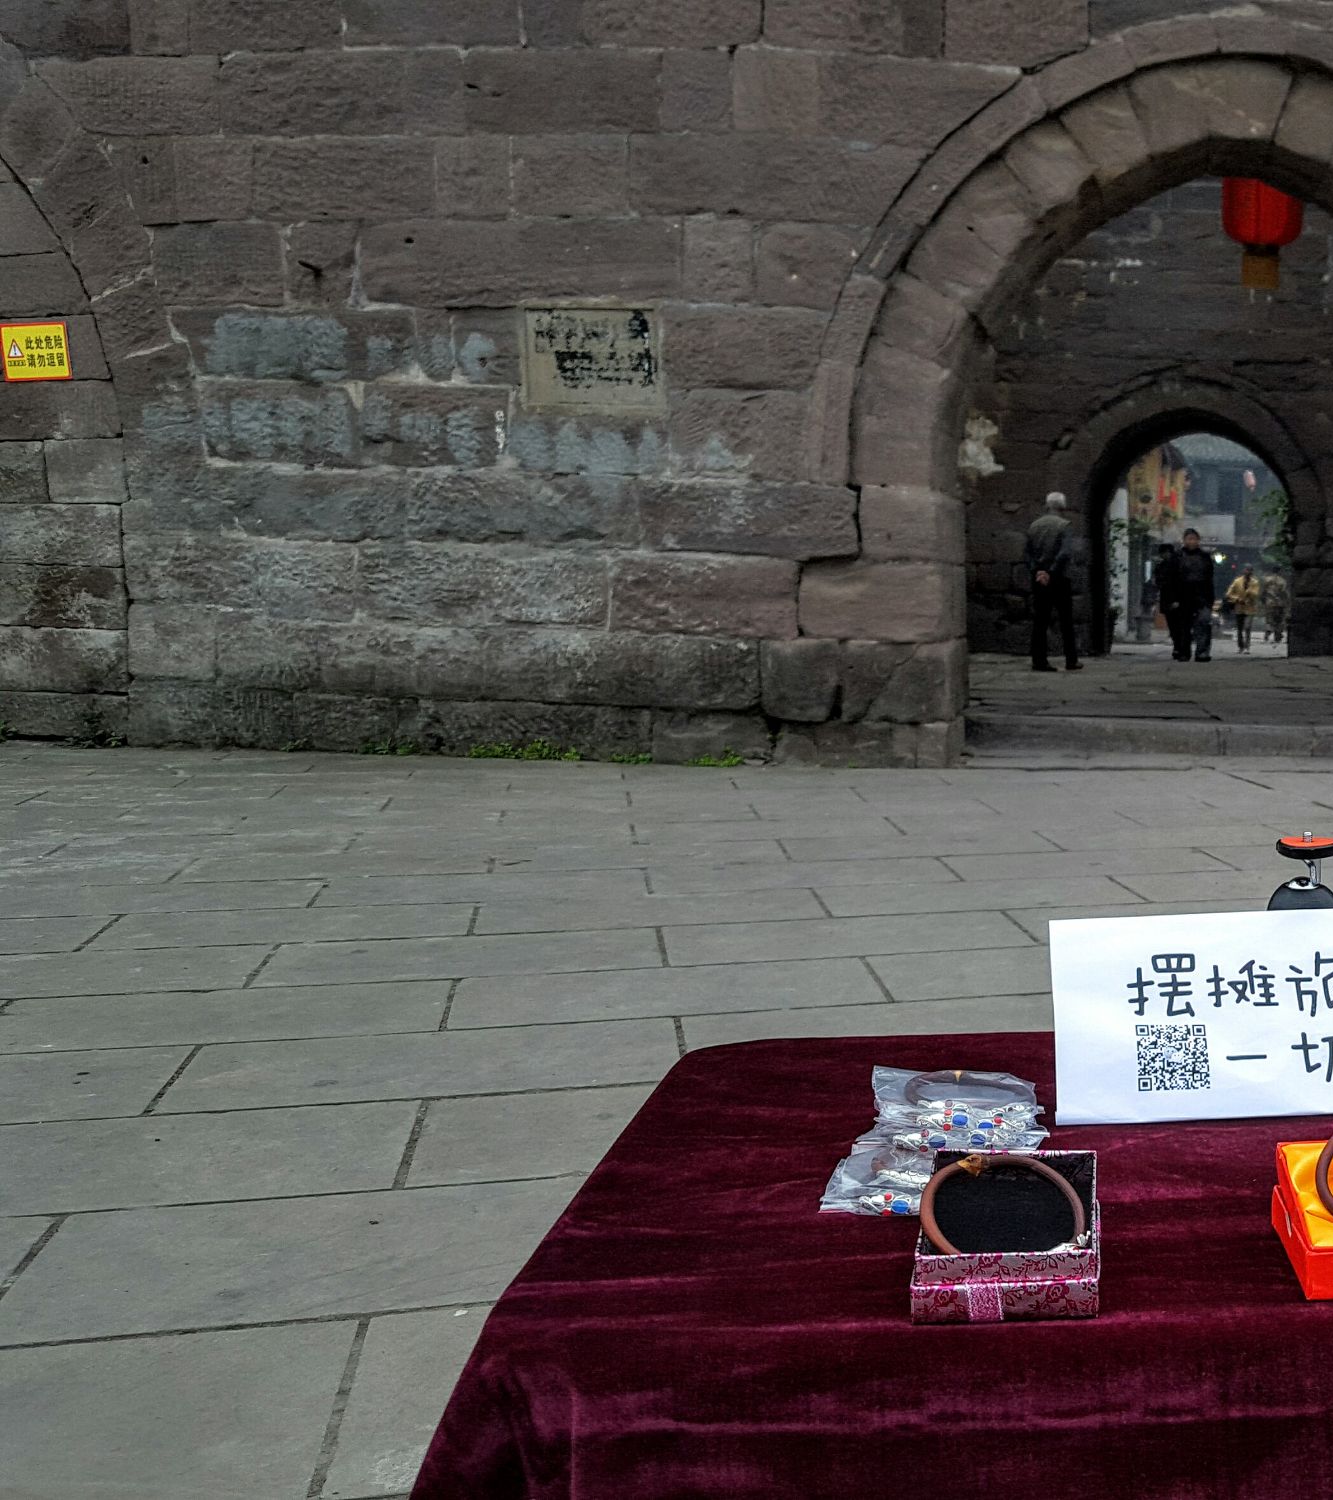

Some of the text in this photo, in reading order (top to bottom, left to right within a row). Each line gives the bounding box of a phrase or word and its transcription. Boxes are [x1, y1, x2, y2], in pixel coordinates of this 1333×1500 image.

[25, 335, 64, 350] 此处危险
[27, 353, 65, 368] 请勿逗留
